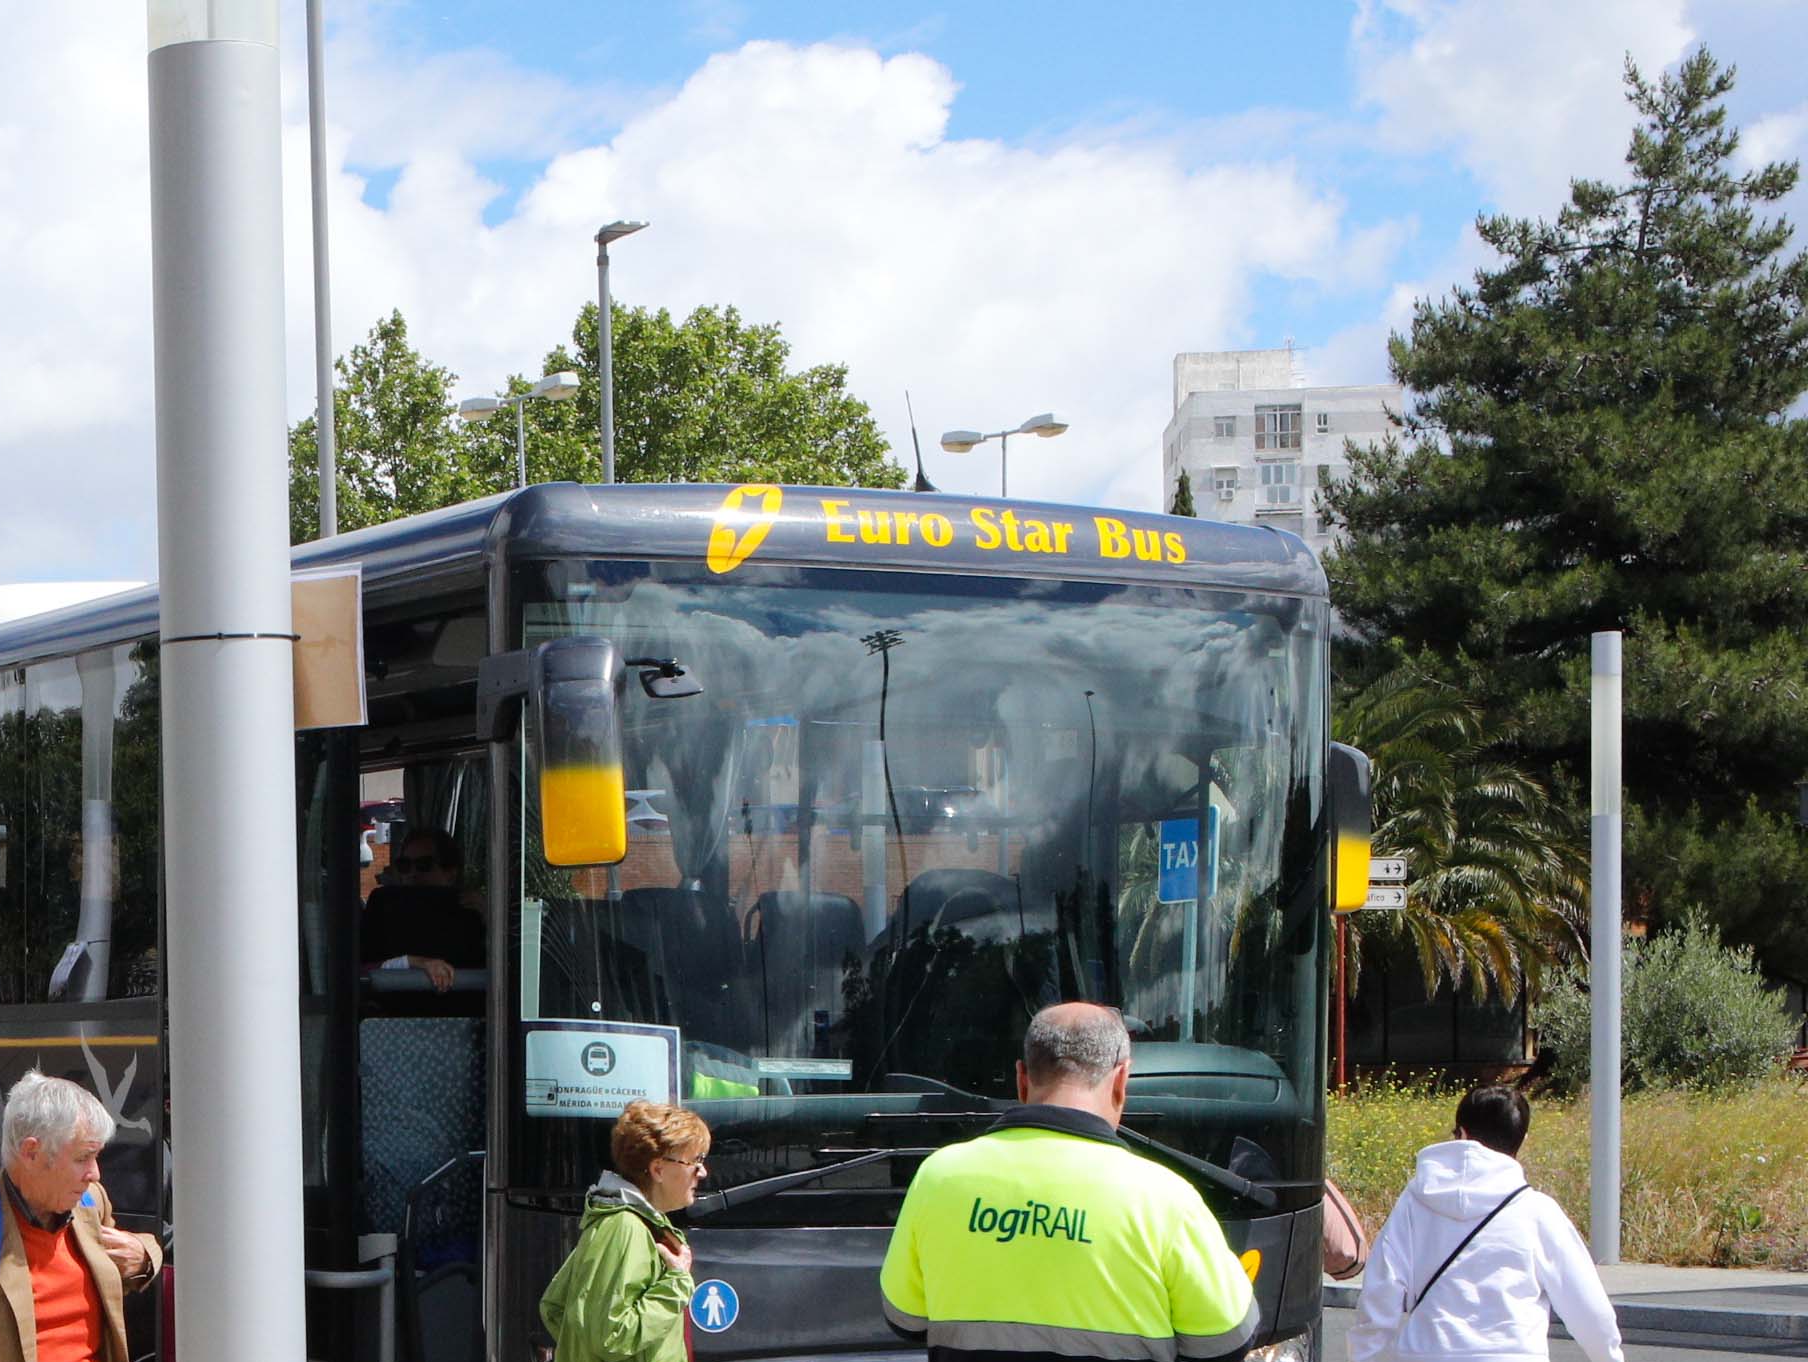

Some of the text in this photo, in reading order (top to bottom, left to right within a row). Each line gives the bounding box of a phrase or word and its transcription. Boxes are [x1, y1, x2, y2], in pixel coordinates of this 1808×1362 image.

[821, 499, 1187, 565] Euro Star Bus
[559, 1098, 625, 1109] MÉRIDA BADA
[611, 1086, 647, 1097] CÁCERES
[968, 1197, 1092, 1244] logiRAIL
